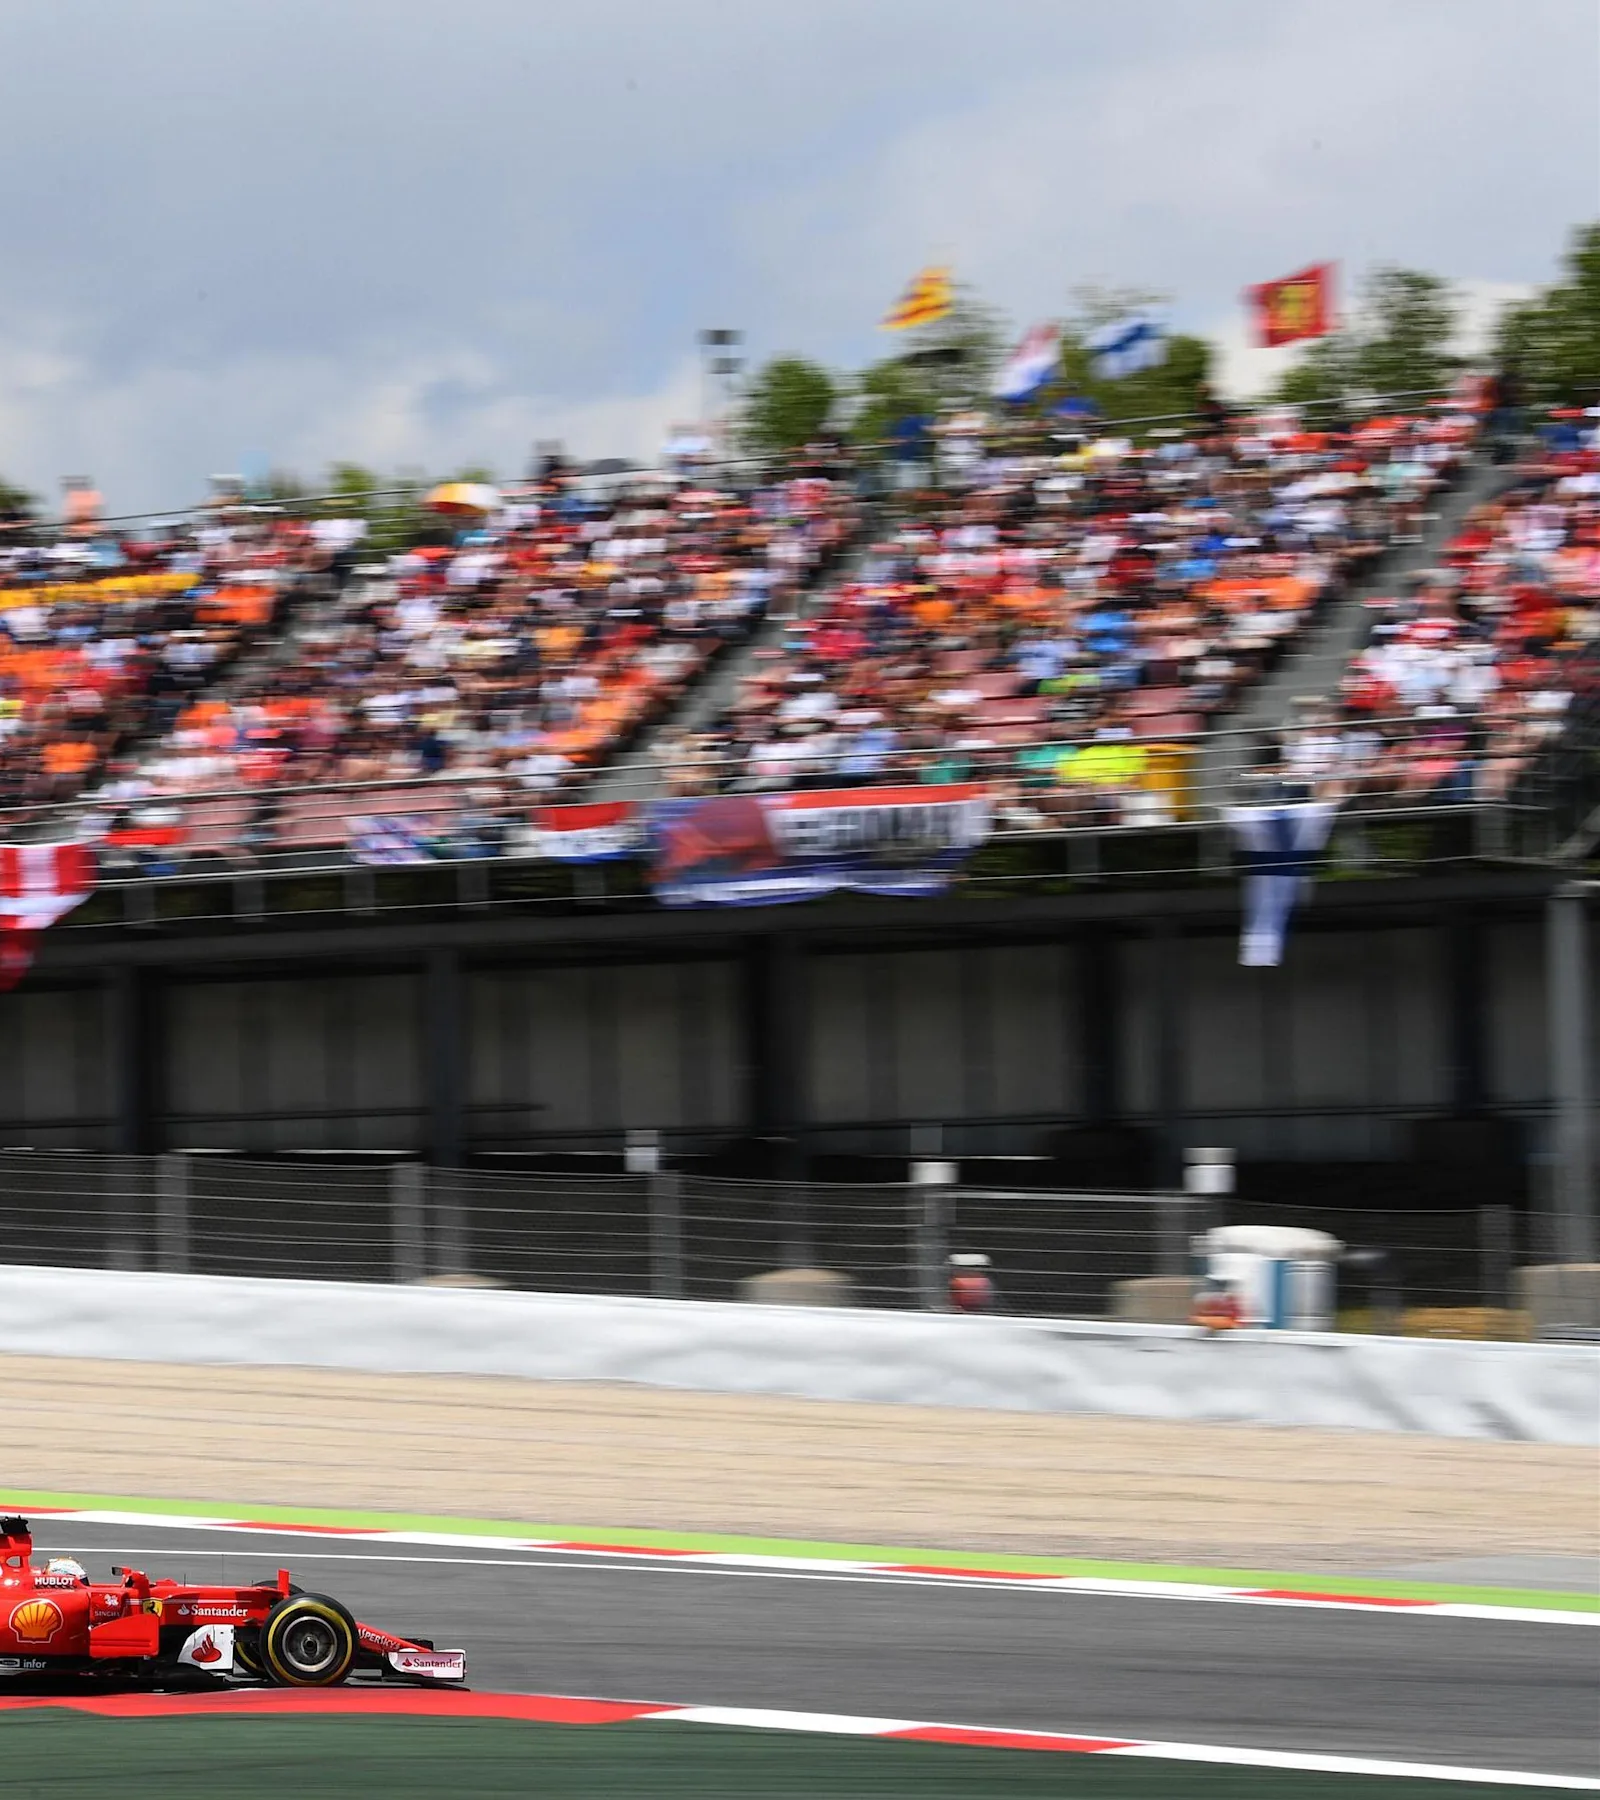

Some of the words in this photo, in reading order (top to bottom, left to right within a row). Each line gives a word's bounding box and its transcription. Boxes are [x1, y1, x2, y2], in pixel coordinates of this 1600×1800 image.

[34, 1577, 75, 1586] HUBLOT
[191, 1605, 248, 1617] Santander
[23, 1659, 47, 1668] infor
[413, 1658, 462, 1669] Santander
